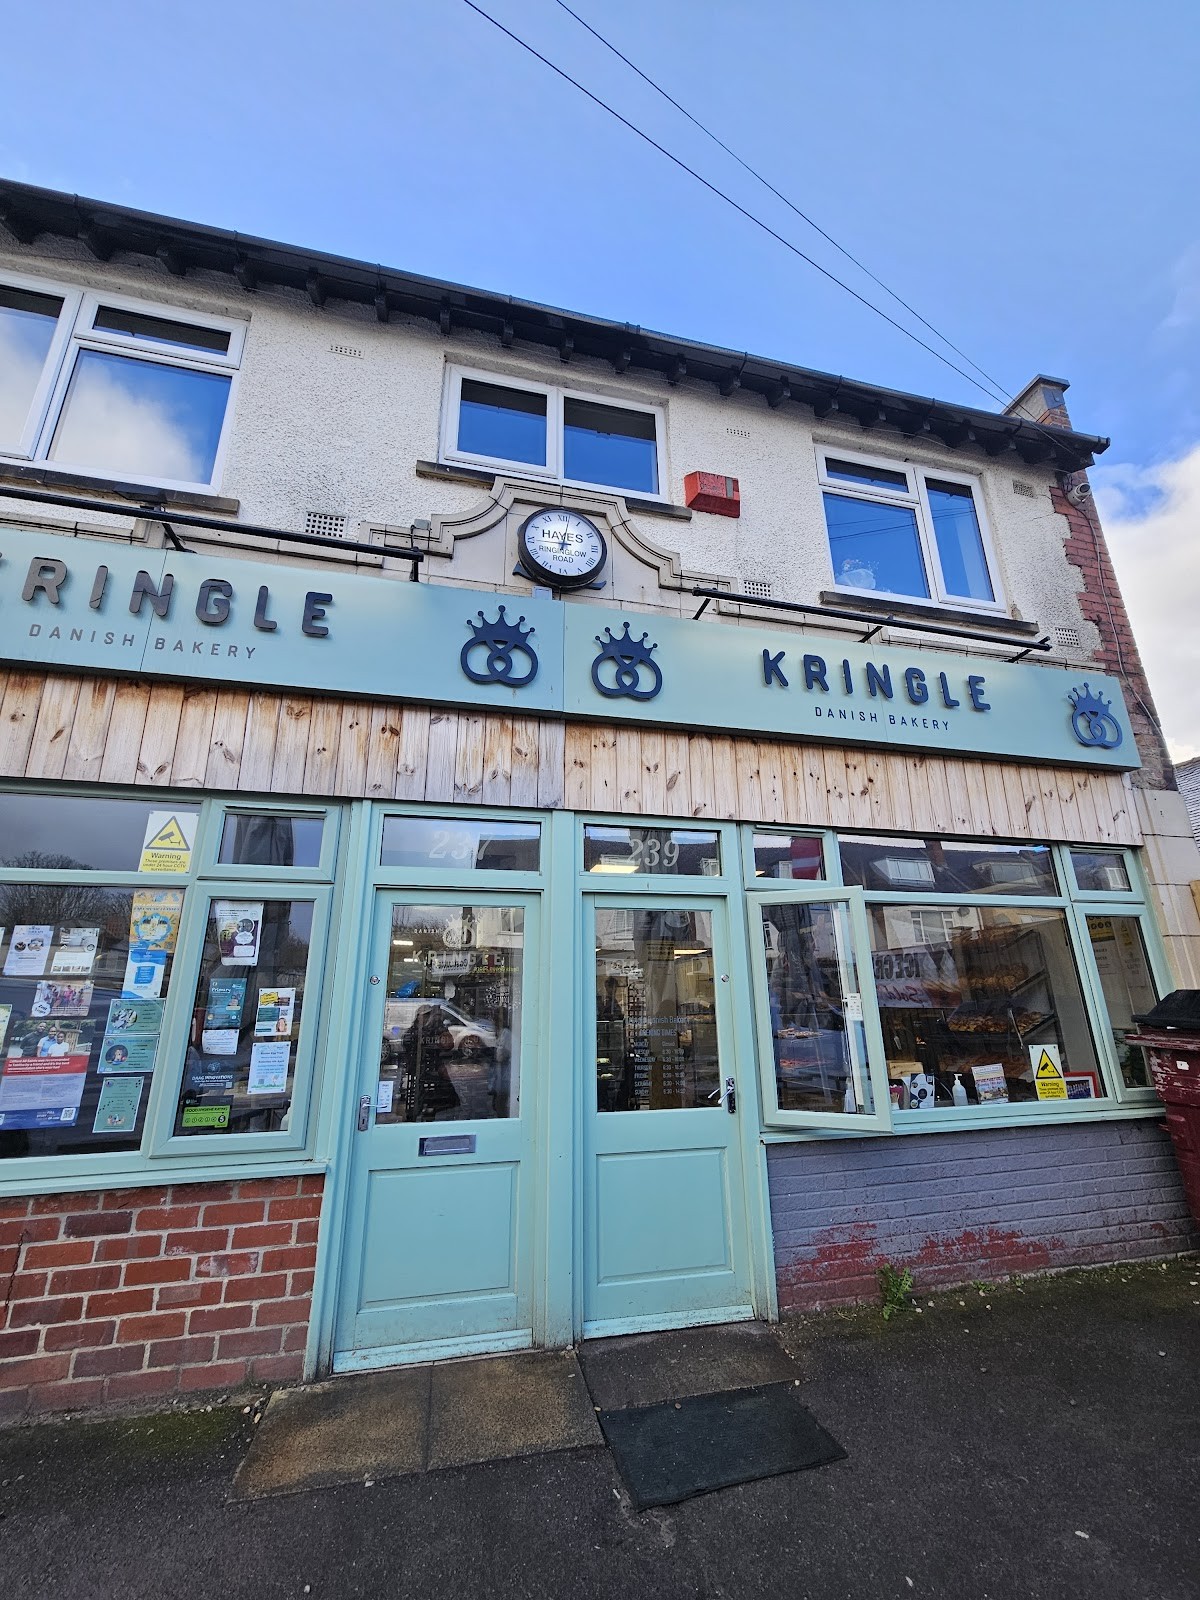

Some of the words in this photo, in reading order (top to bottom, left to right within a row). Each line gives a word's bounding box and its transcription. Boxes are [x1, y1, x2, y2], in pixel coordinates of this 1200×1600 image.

[542, 529, 584, 544] HAYES
[538, 545, 587, 558] RINGINGLOW
[552, 554, 574, 564] ROAD
[0, 552, 334, 637] RINGLE
[28, 623, 137, 648] DANISH
[154, 637, 258, 661] BAKERY
[761, 648, 992, 712] KRINGLE
[814, 706, 880, 724] DANISH
[888, 714, 951, 732] BAKERY
[151, 852, 182, 861] Warning
[428, 830, 495, 860] 237
[627, 838, 680, 867] 239
